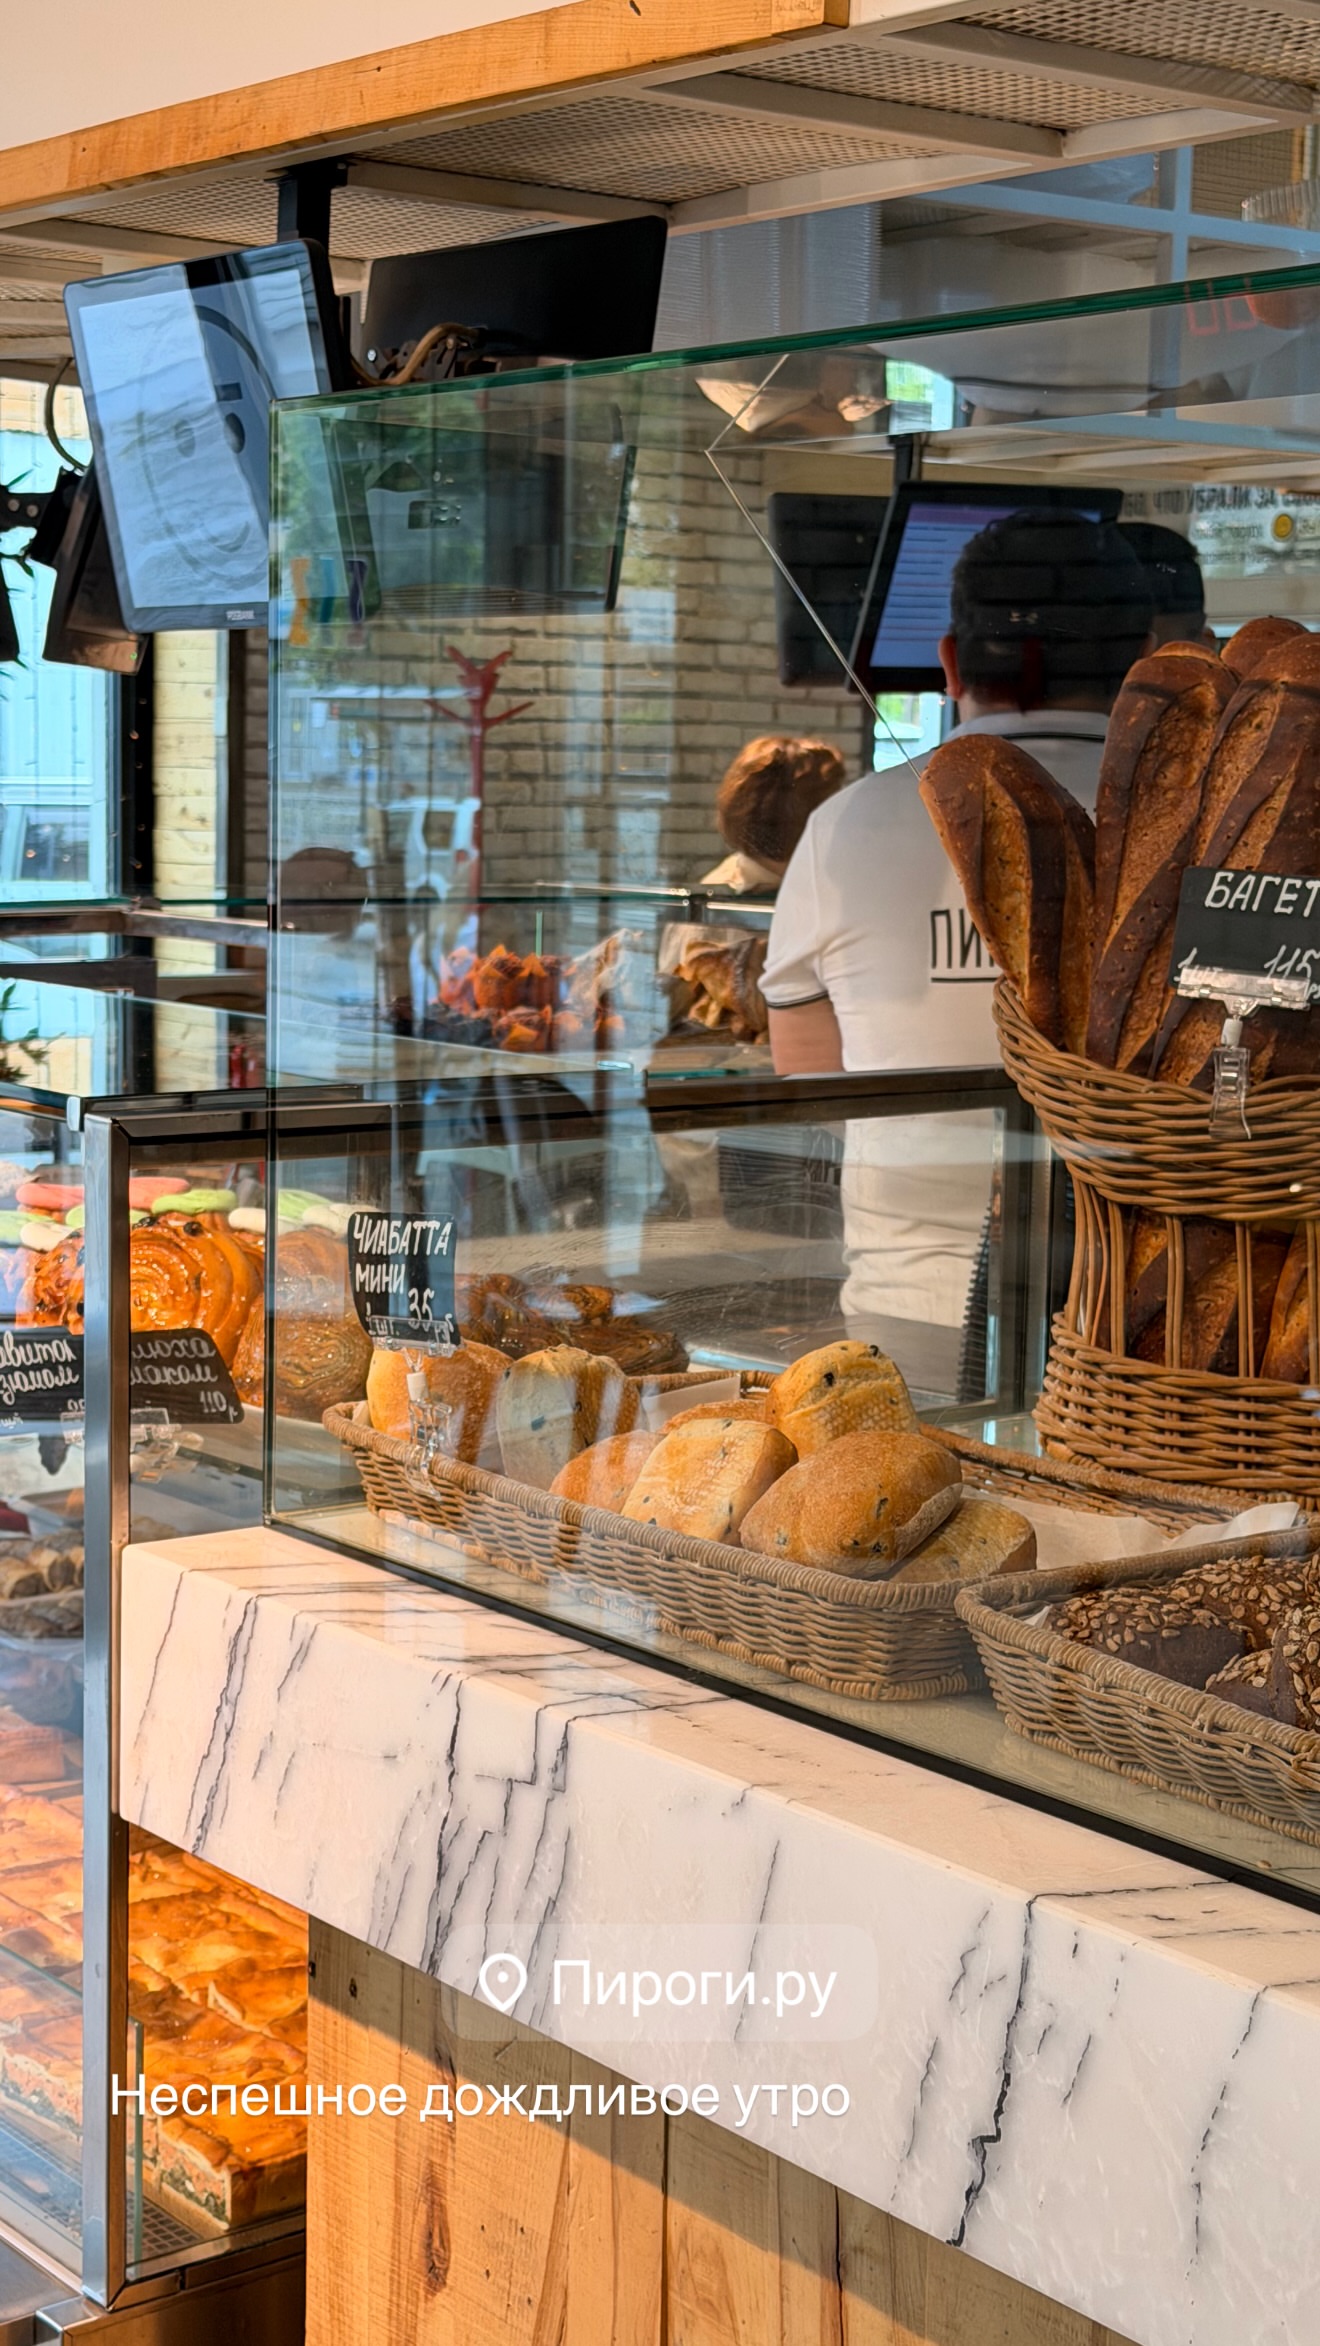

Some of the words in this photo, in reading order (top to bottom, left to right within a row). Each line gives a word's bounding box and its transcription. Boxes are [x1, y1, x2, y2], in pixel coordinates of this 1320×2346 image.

[1205, 871, 1320, 918] БАГЕТ
[931, 908, 995, 970] ПИ
[353, 1214, 453, 1256] ЧИАБАТТА
[355, 1262, 406, 1294] МИНИ
[408, 1287, 435, 1333] 35
